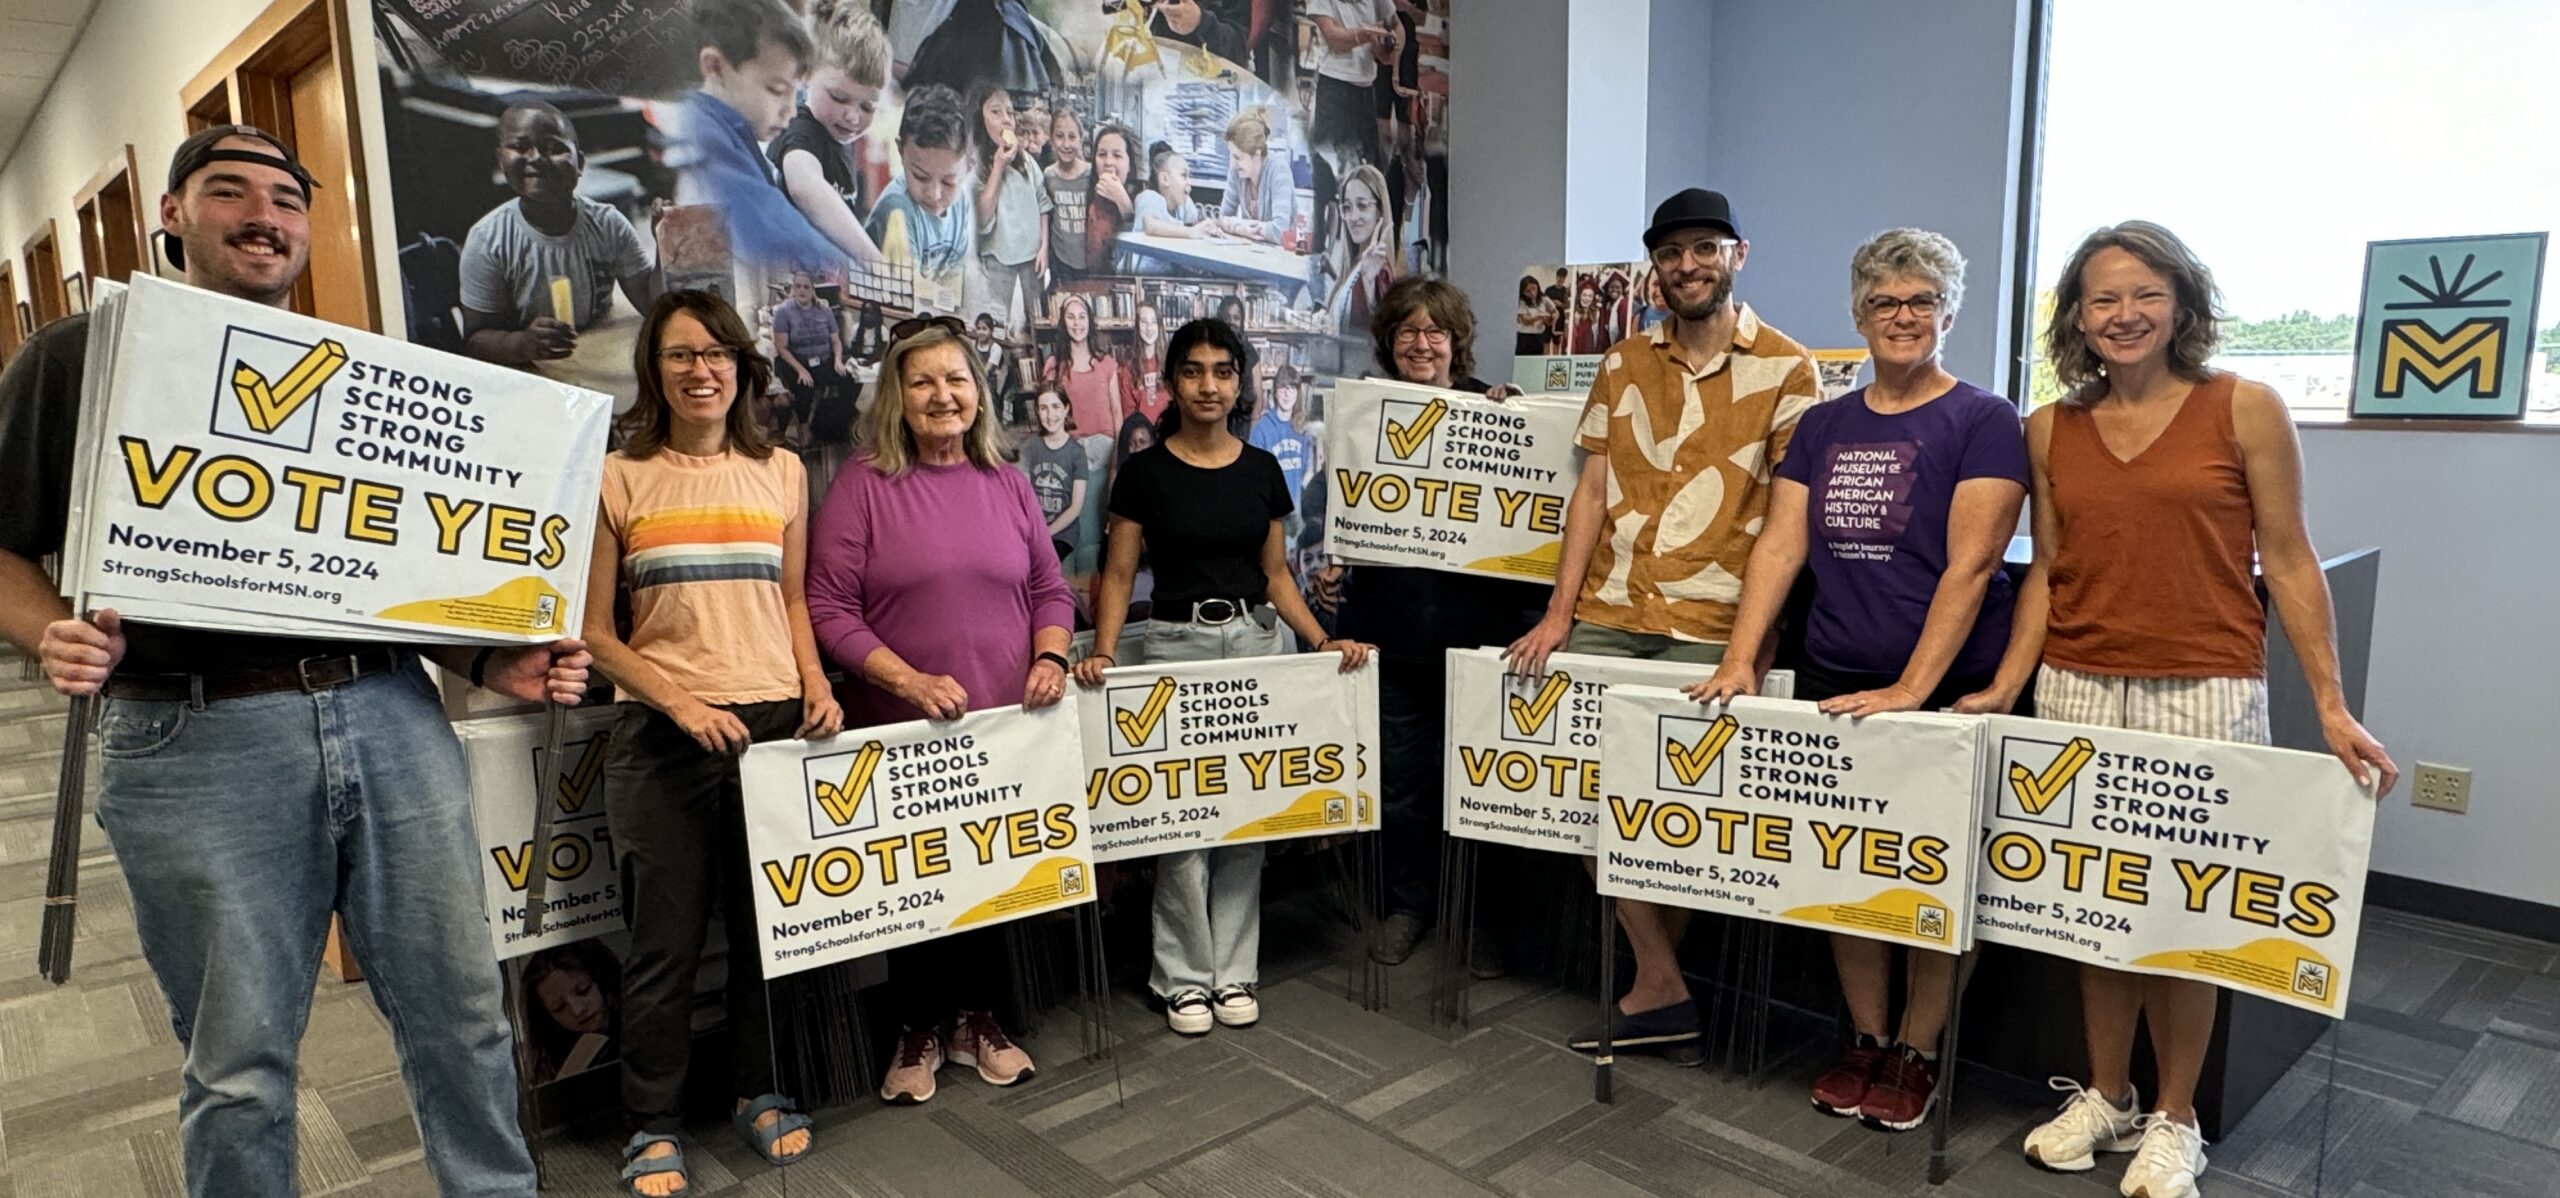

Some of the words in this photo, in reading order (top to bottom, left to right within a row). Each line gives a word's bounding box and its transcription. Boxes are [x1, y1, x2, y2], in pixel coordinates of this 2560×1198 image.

[349, 361, 473, 405] STRONG
[343, 386, 485, 434] SCHOOLS
[1449, 408, 1526, 429] STRONG
[339, 411, 466, 453] STRONG
[1447, 425, 1534, 447] SCHOOLS
[335, 437, 523, 488] COMMUNITY
[1445, 440, 1520, 461] STRONG
[1837, 450, 1897, 461] NATIONAL
[1443, 457, 1557, 483] COMMUNITY
[1829, 476, 1884, 487] AFRICAN
[1832, 463, 1886, 474] MUSEUM
[118, 436, 403, 546] VOTE
[424, 492, 571, 570] YES
[1336, 469, 1482, 523] VOTE
[1494, 486, 1566, 535] YE
[1825, 502, 1878, 515] HISTORY
[1826, 489, 1894, 501] AMERICAN
[1335, 516, 1410, 539] November
[1412, 527, 1425, 542] 5,
[1429, 528, 1467, 545] 2024
[1825, 516, 1881, 530] CULTURE
[109, 523, 271, 567] November
[276, 548, 302, 575] 5,
[308, 553, 379, 581] 2024
[1333, 536, 1446, 561] StrongSchoolsforMSN.org
[101, 559, 342, 604] StrongSchoolsforMSN.org
[1179, 678, 1258, 697] STRONG
[1180, 694, 1270, 713] SCHOOLS
[1572, 699, 1602, 713] SC
[1180, 711, 1259, 730] STRONG
[1180, 723, 1298, 746] COMMUNITY
[886, 735, 975, 762] STRONG
[1570, 732, 1600, 748] CO
[1741, 726, 1840, 750] STRONG
[889, 752, 989, 781] SCHOOLS
[1459, 746, 1600, 801] VOTE
[1740, 747, 1854, 771] SCHOOLS
[2098, 752, 2215, 781] STRONG
[891, 773, 980, 800] STRONG
[1086, 755, 1228, 810] VOTE
[1239, 744, 1345, 791] YES
[1740, 765, 1838, 790] STRONG
[2095, 773, 2229, 805] SCHOOLS
[893, 783, 1024, 820] COMMUNITY
[1460, 796, 1537, 820] November
[1542, 809, 1555, 824] 5,
[1739, 784, 1889, 815] COMMUNITY
[2094, 794, 2210, 824] STRONG
[1090, 810, 1158, 834] ovember
[1161, 812, 1176, 827] 5,
[1178, 805, 1220, 822] 2024
[1459, 817, 1581, 843] StrongSchoolsforMSN.org
[1607, 795, 1793, 863] VOTE
[1809, 820, 1949, 885] YES
[2092, 815, 2270, 855] COMMUNITY
[761, 827, 951, 909] VOTE
[961, 803, 1077, 865] YES
[1609, 851, 1705, 879] November
[1708, 865, 1725, 884] 5,
[1729, 868, 1780, 889] 2024
[1608, 873, 1755, 906] StrongSchoolsforMSN.org
[1981, 827, 2151, 907] OTE
[2171, 858, 2339, 938] YES
[502, 891, 599, 924] Noember
[772, 908, 874, 940] November
[878, 897, 894, 918] 5,
[898, 889, 945, 911] 2024
[1977, 893, 2047, 920] ember
[2052, 902, 2070, 924] 5,
[2076, 908, 2132, 935] 2024
[775, 918, 925, 961] StrongSchoolsforMSN.org
[1976, 915, 2102, 951] SchoolsforMSN.org
